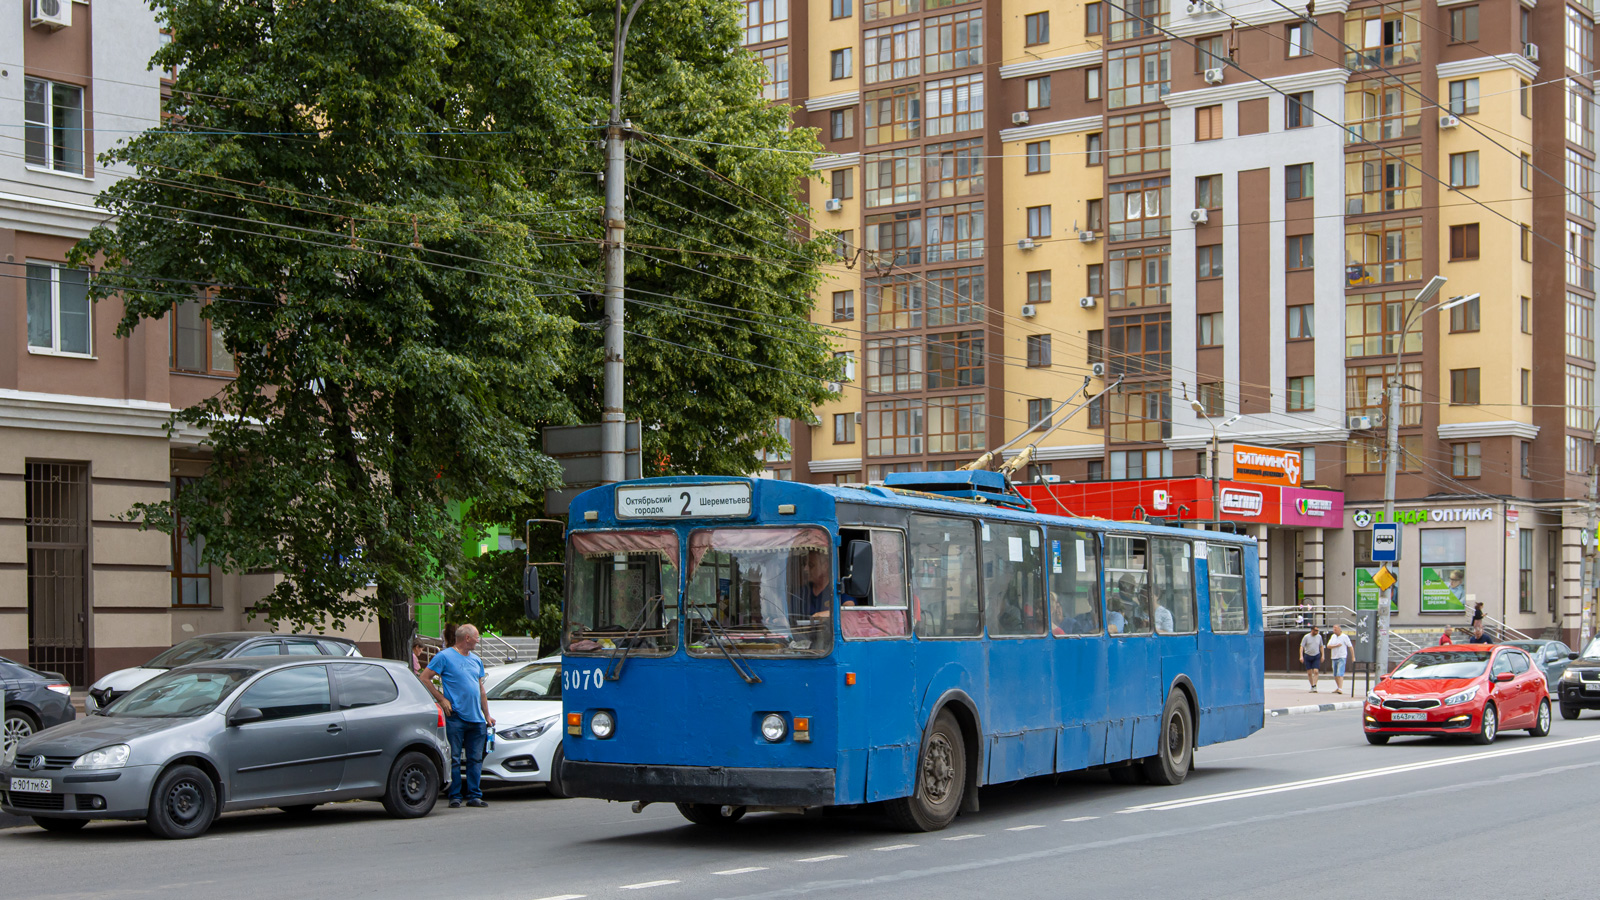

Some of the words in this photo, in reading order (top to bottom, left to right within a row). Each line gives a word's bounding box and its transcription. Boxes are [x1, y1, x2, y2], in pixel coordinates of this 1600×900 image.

[625, 495, 672, 506] Октябрьский
[679, 491, 692, 515] 2
[1223, 493, 1261, 510] МАГНИТ
[635, 506, 664, 515] городок
[1375, 509, 1428, 525] ПНДА
[1431, 507, 1493, 522] ОПТИКА
[563, 668, 604, 690] 3070
